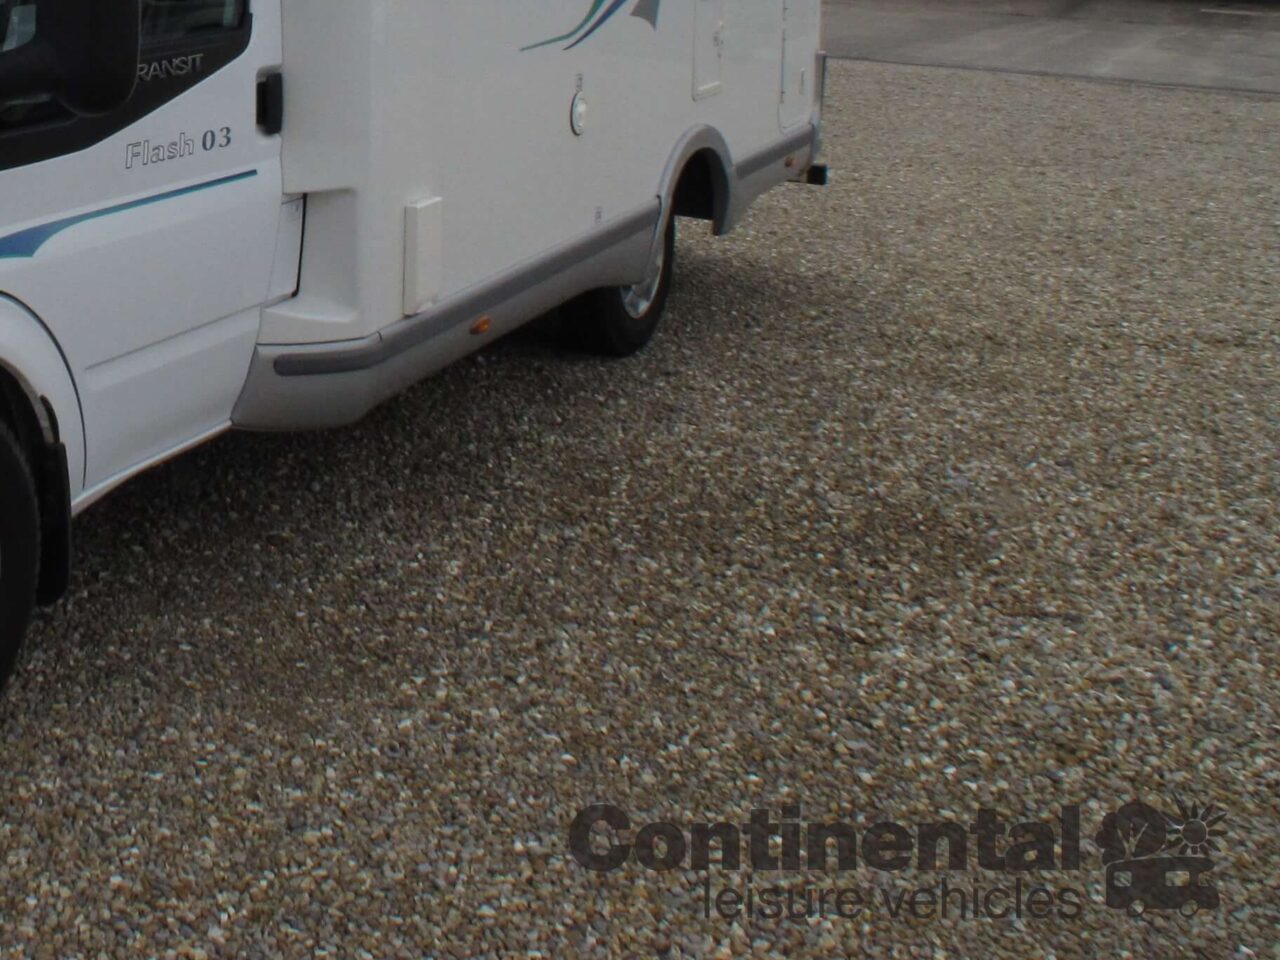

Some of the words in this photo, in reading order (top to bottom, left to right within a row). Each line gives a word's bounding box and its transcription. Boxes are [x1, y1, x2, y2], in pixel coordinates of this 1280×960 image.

[137, 53, 204, 81] RANSIT
[125, 132, 195, 169] Flash
[202, 126, 232, 151] 03
